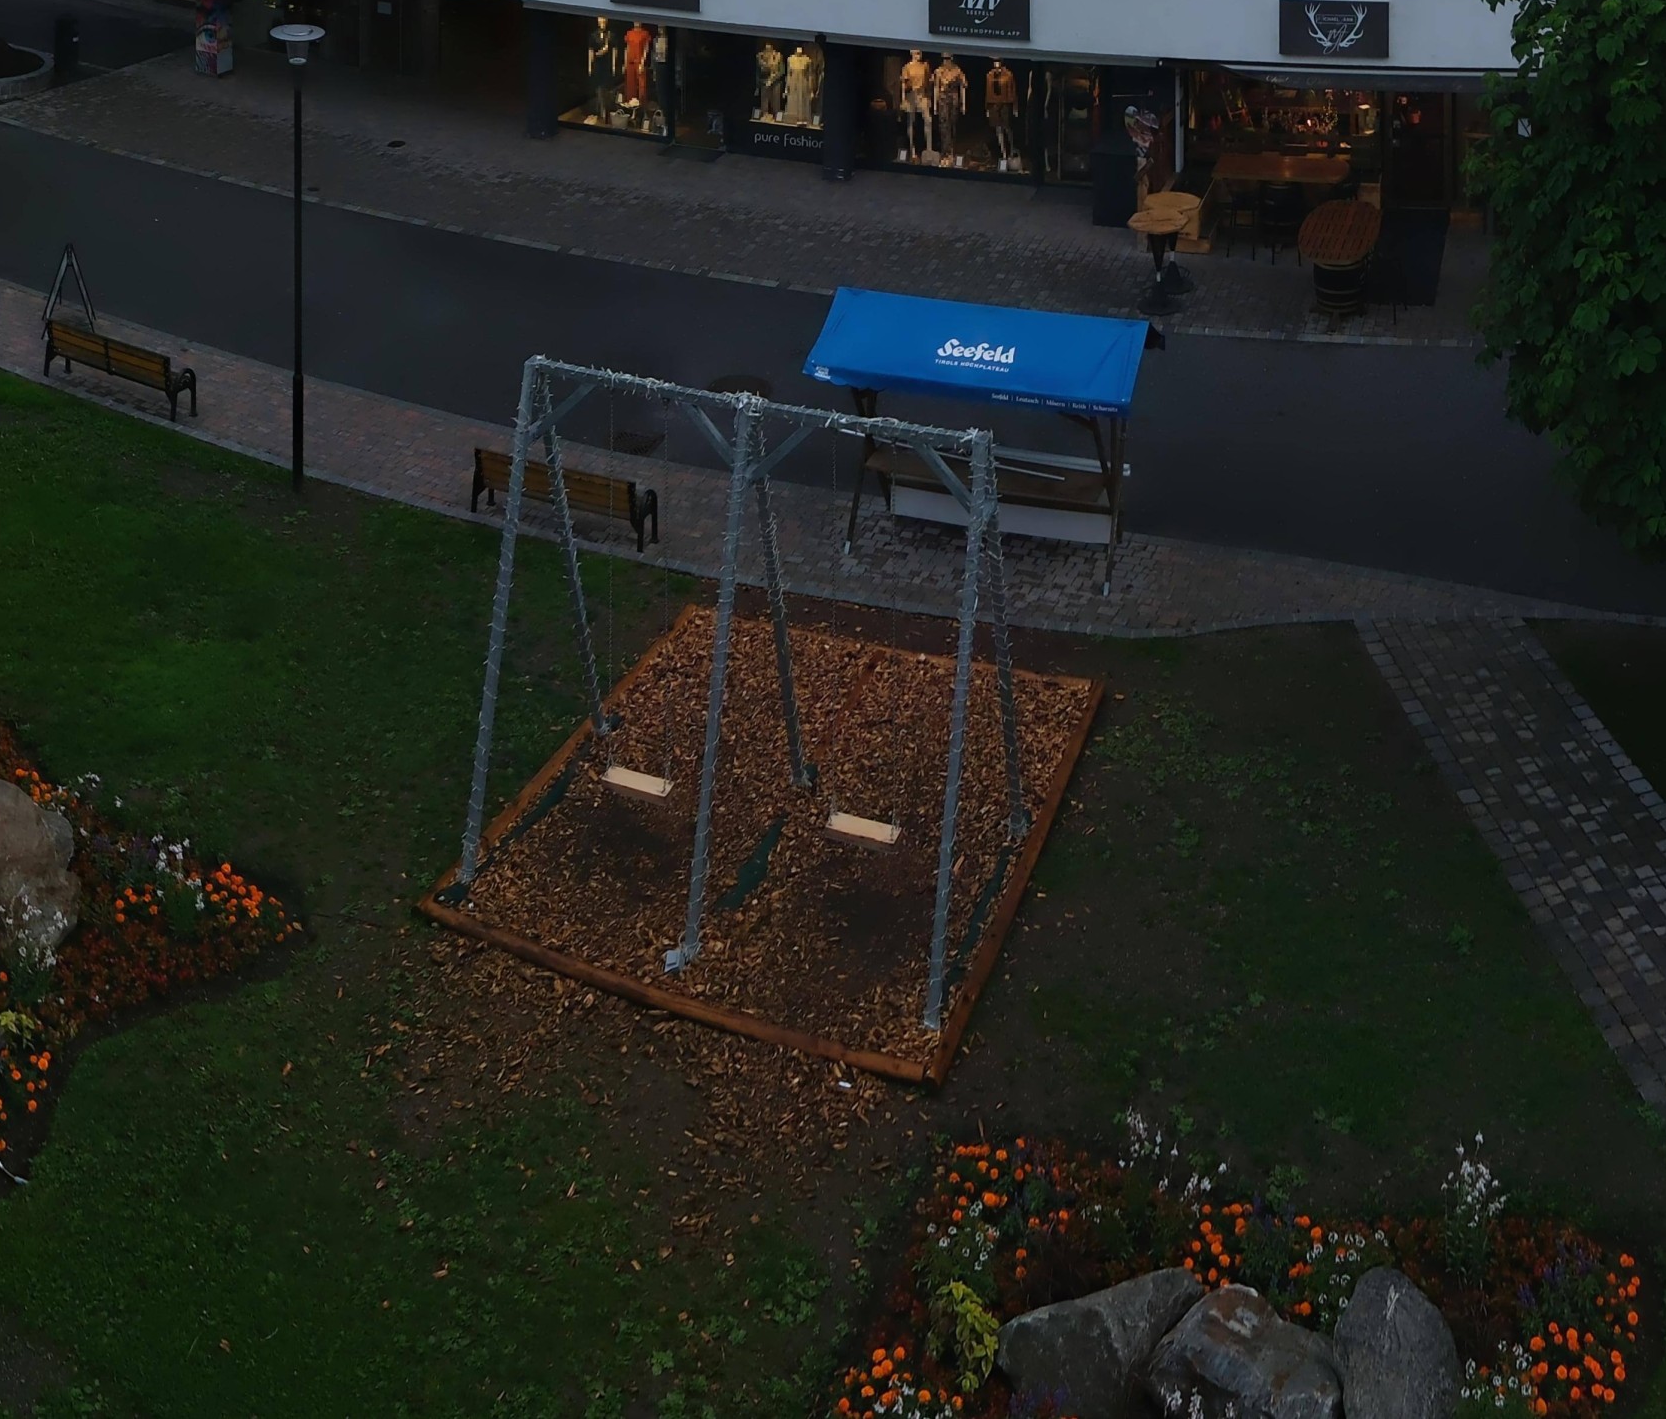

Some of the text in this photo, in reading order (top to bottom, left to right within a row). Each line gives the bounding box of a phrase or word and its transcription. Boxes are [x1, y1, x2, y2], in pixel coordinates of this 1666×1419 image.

[966, 9, 995, 17] SEEFELD
[939, 24, 968, 34] SEEFELD
[970, 27, 1003, 36] SHOPPING
[754, 132, 780, 144] pure
[938, 339, 1015, 364] Seefeld
[935, 358, 959, 367] TIROLS
